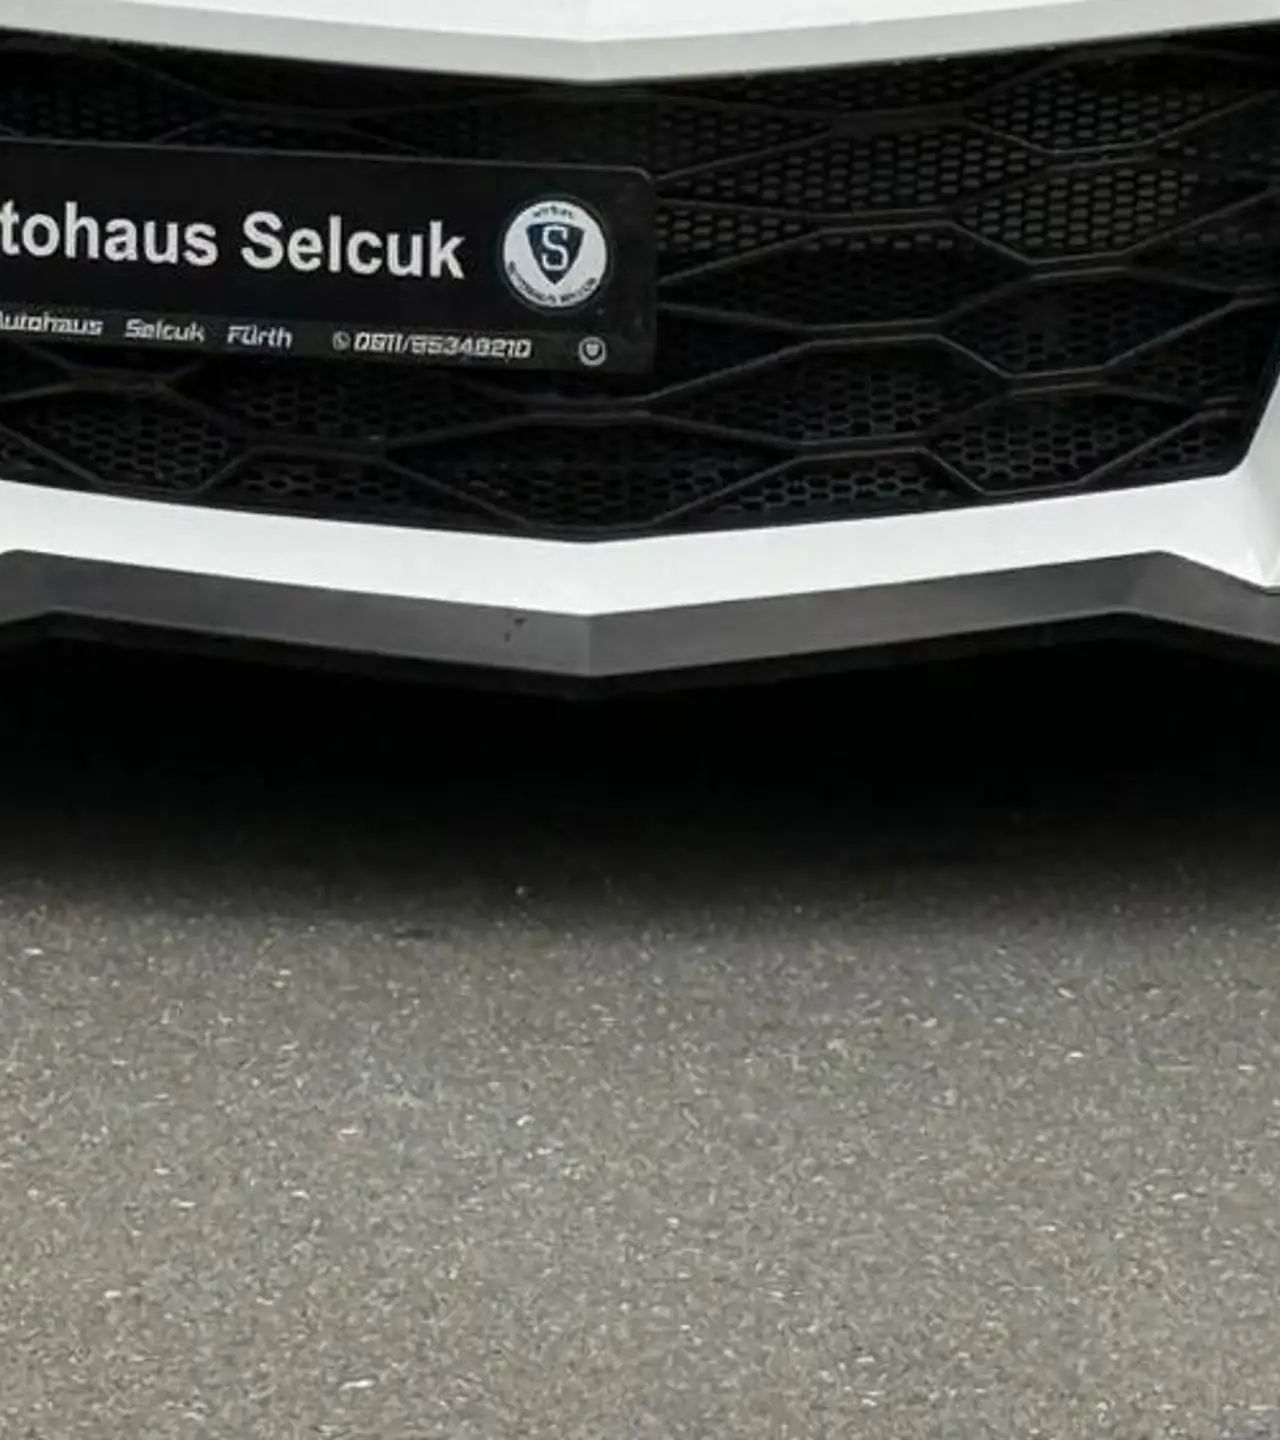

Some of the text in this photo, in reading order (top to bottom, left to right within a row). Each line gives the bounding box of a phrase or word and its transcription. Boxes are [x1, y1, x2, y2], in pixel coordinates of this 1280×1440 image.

[241, 210, 466, 280] Selcuk
[124, 318, 206, 343] Selcuk
[227, 324, 294, 350] Fürth
